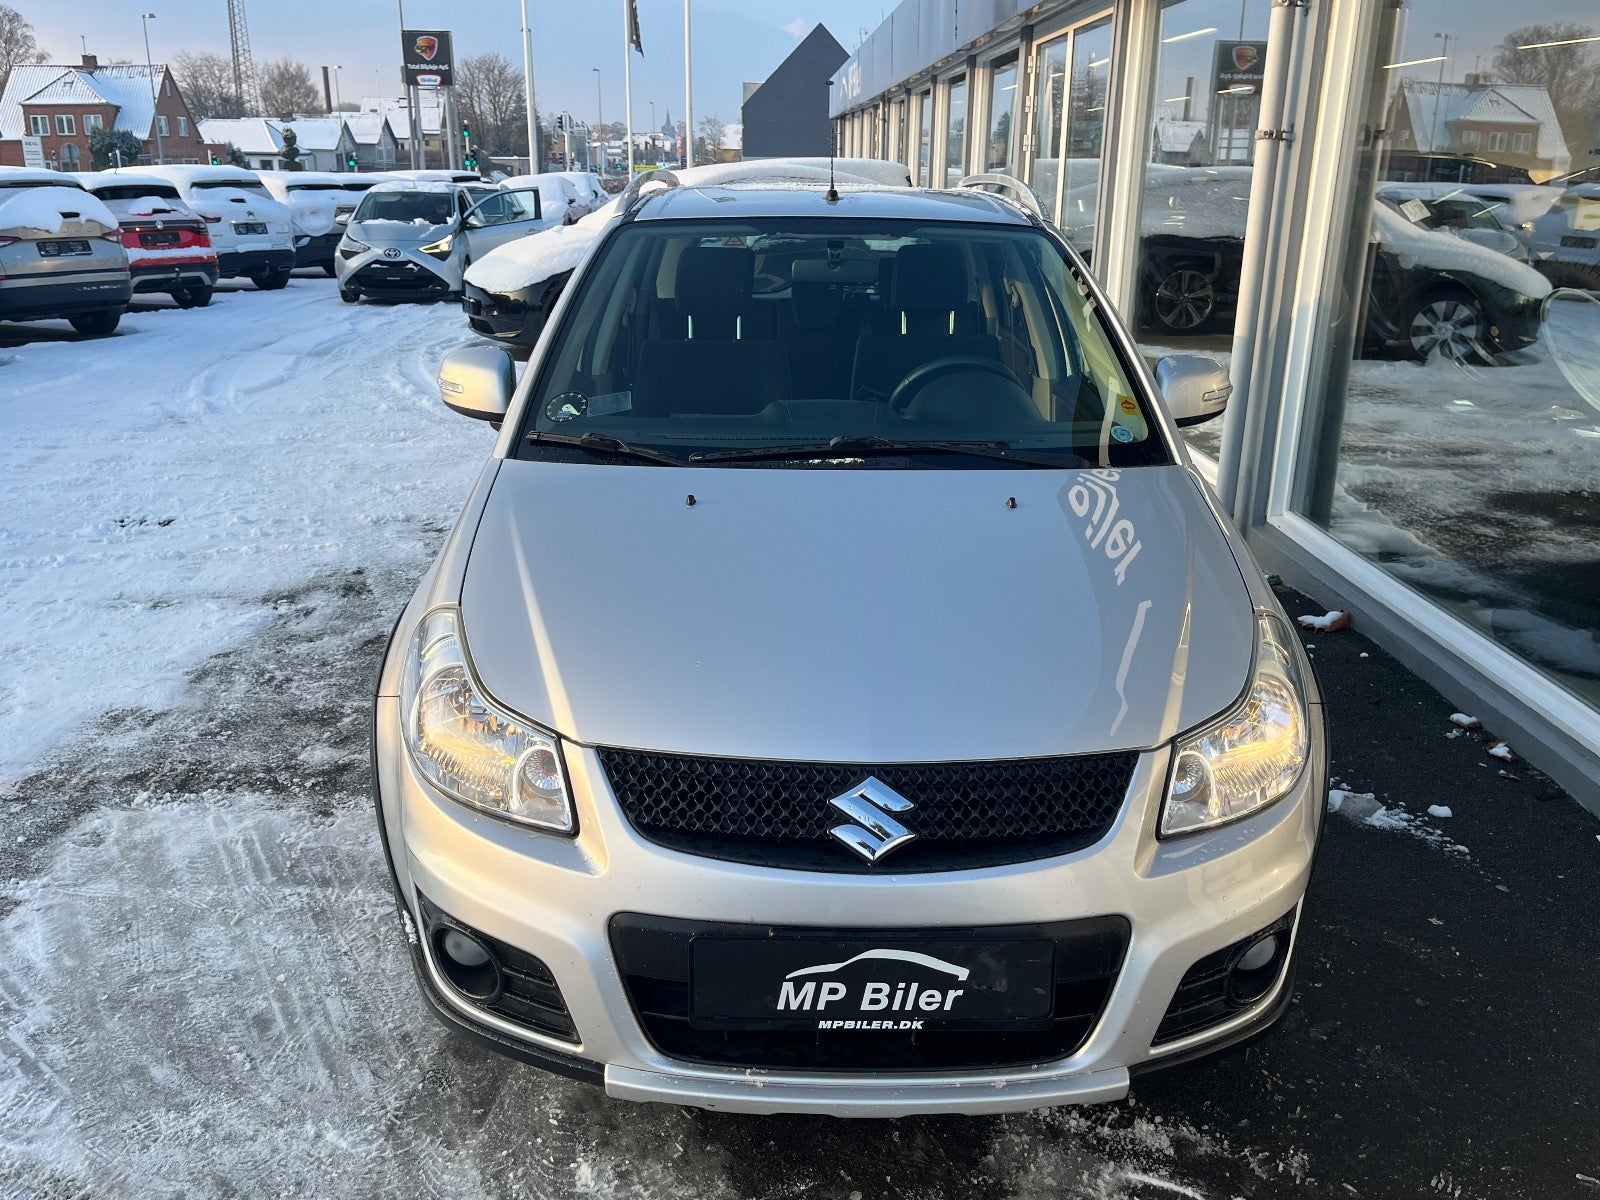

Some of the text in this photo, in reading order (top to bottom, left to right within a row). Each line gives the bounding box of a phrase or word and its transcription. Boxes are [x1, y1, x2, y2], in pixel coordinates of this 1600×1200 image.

[776, 981, 964, 1011] MP Biler
[818, 1020, 924, 1030] MPBILER.DK
